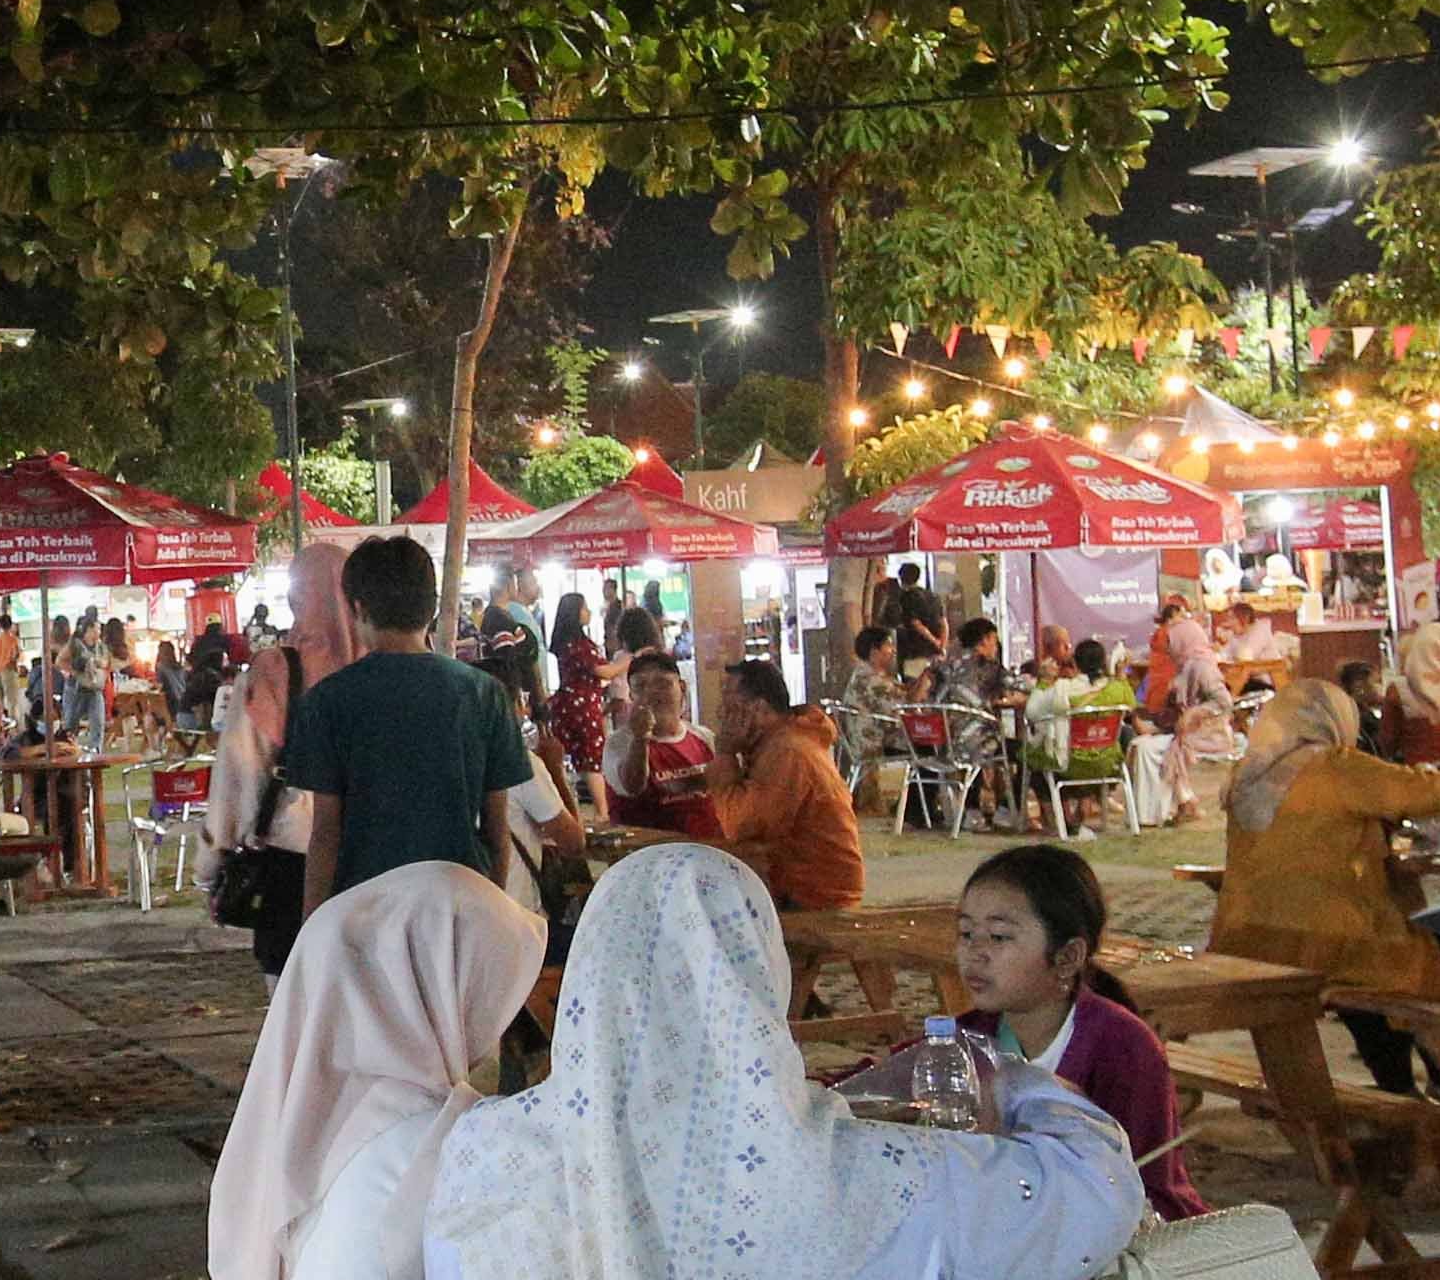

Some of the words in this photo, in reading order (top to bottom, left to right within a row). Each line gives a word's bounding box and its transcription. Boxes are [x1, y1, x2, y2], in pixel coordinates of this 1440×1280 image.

[698, 482, 747, 511] Kahf
[977, 522, 1000, 534] Teh
[1002, 520, 1049, 533] Terbaik
[15, 536, 39, 548] Teh
[41, 534, 94, 547] Terbaik
[944, 536, 969, 549] Ada
[10, 550, 24, 563] di
[25, 549, 97, 565] Pucuknya!
